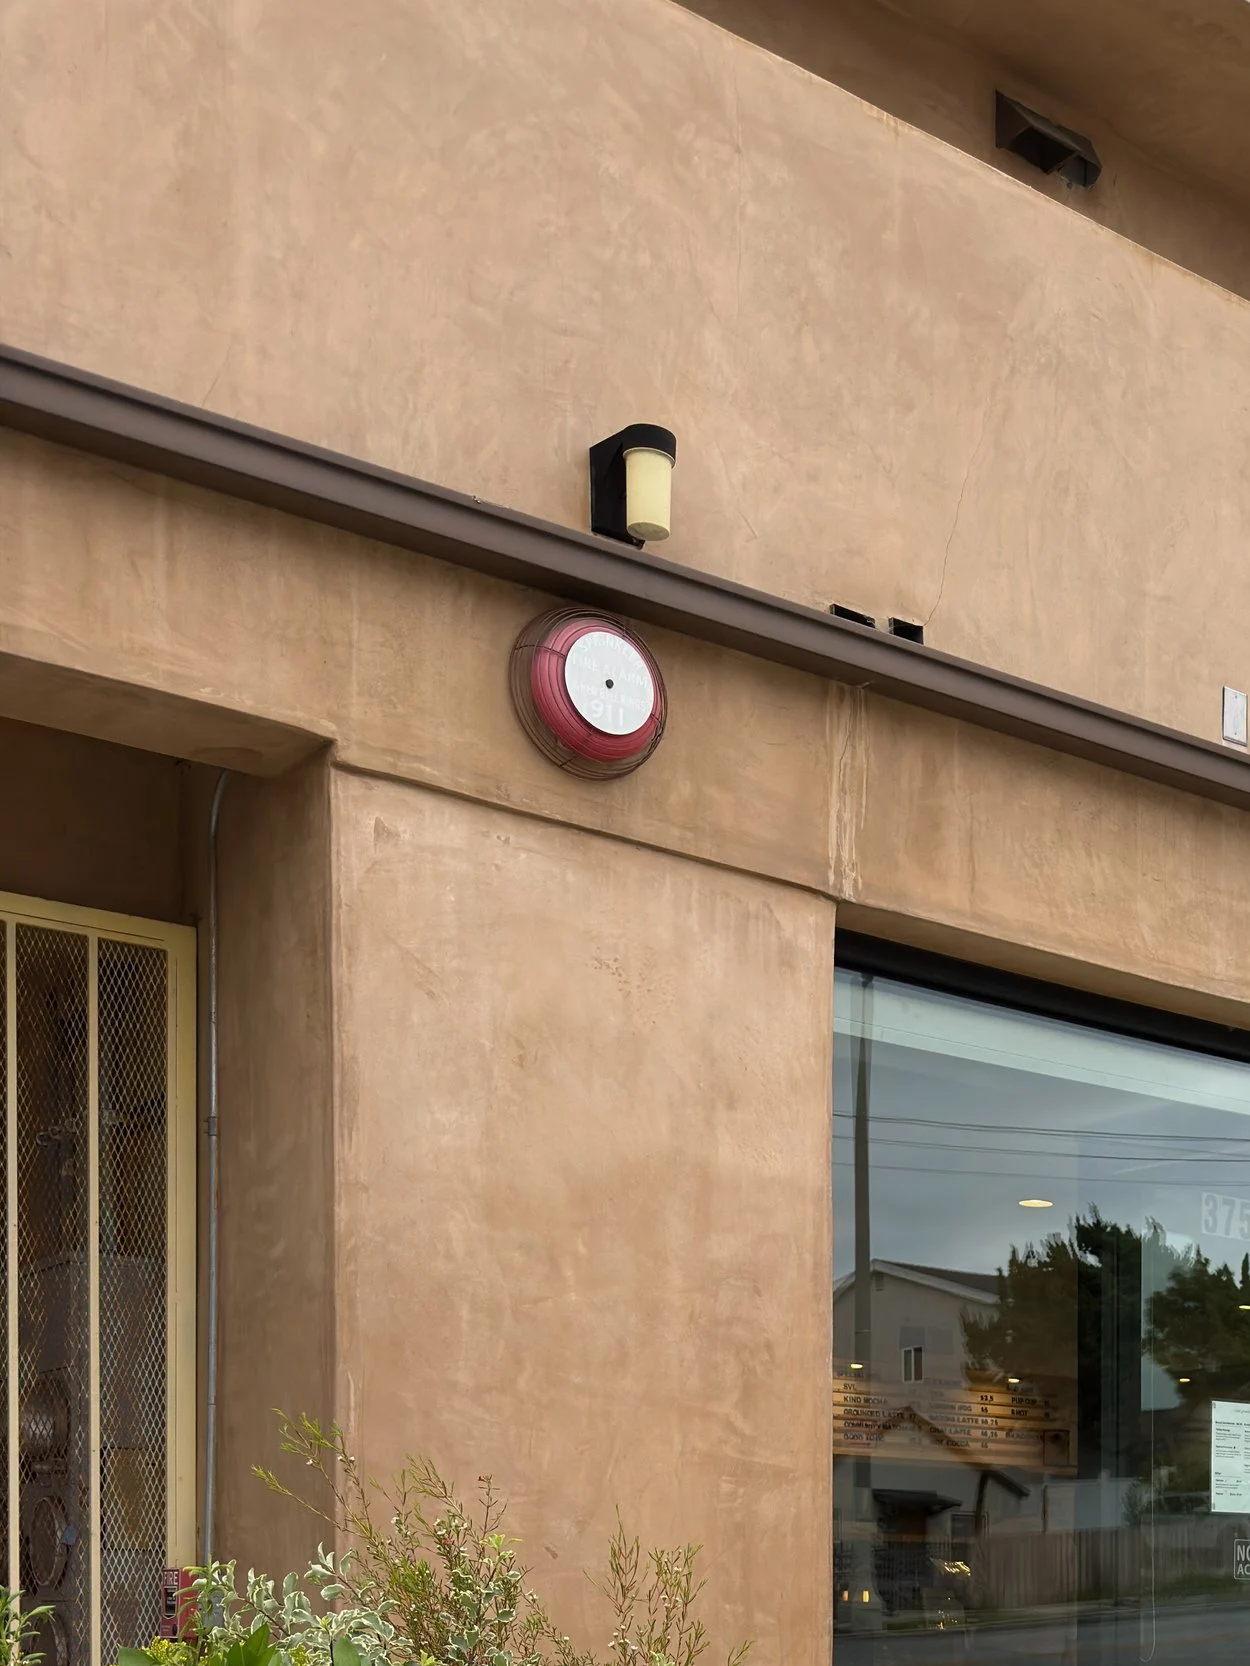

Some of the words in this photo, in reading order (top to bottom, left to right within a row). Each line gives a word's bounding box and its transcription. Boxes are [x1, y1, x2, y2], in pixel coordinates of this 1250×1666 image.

[579, 634, 645, 671] SPRINKLER
[572, 655, 600, 673] FIRE
[602, 664, 648, 689] ALARM
[591, 699, 625, 727] 911
[164, 1571, 179, 1585] FIRE
